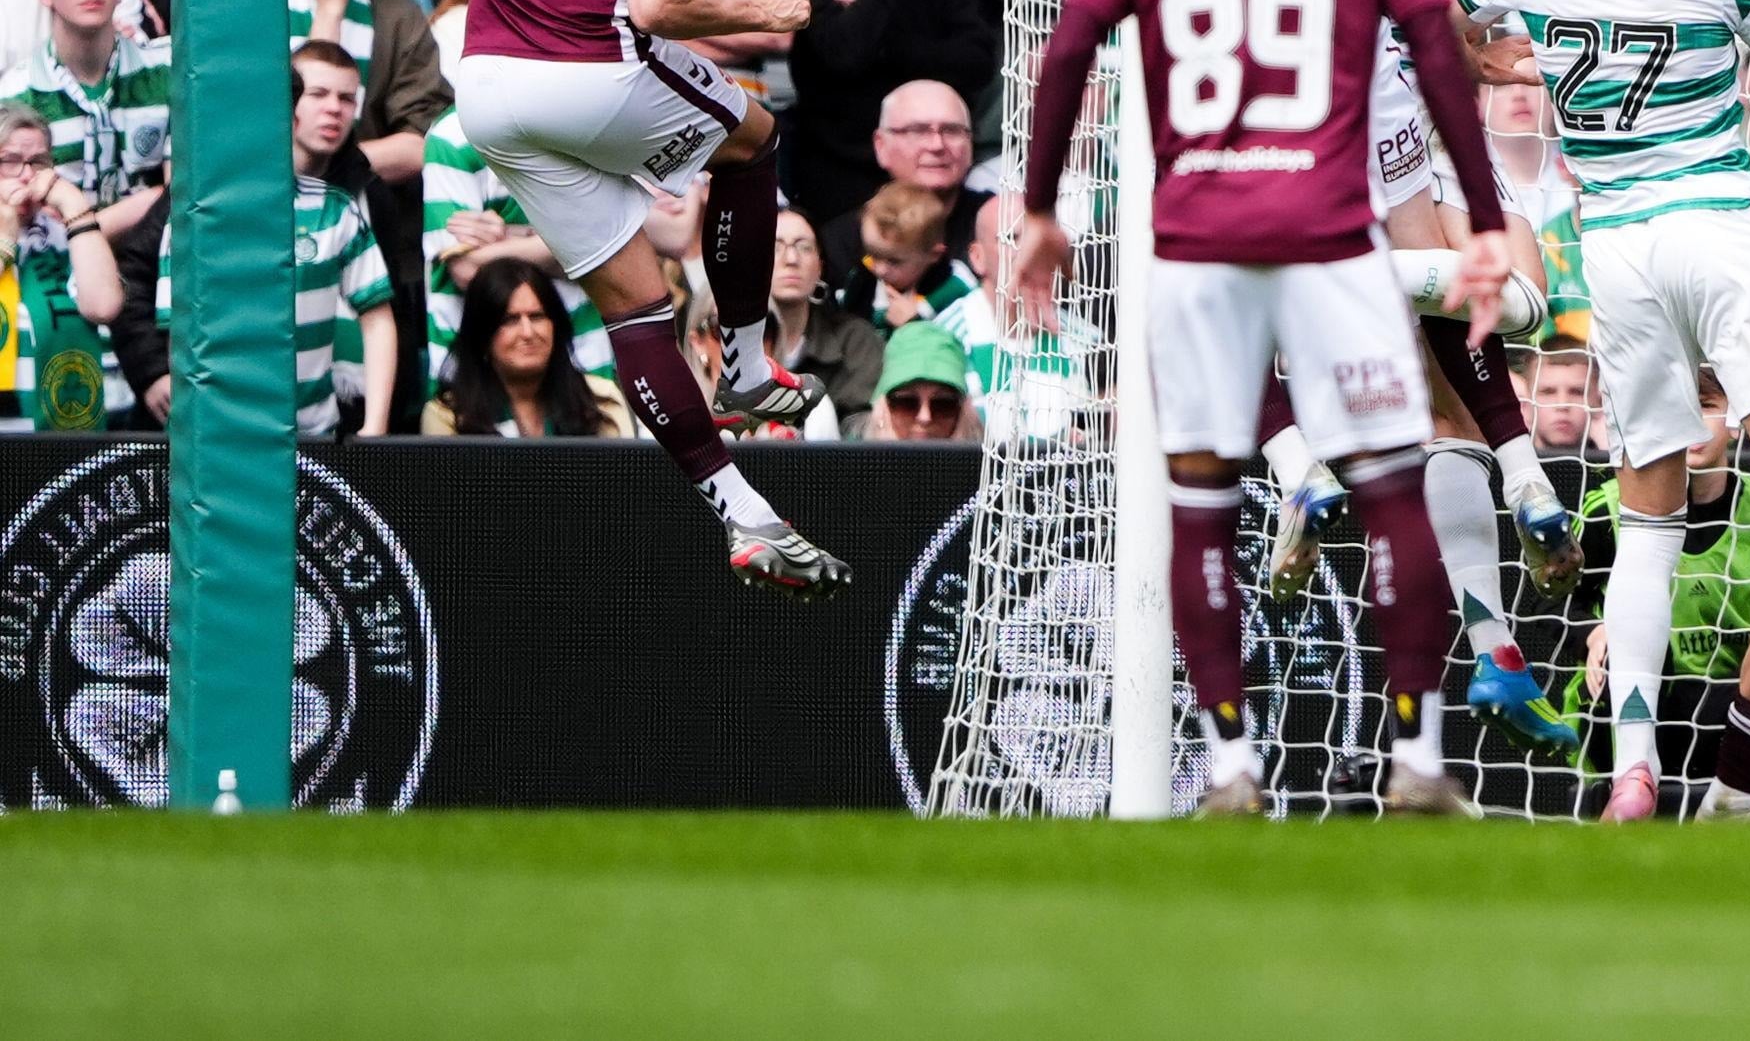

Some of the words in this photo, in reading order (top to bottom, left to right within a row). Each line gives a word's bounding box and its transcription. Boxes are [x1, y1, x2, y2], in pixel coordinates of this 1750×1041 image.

[1544, 16, 1678, 135] 27
[1376, 117, 1421, 164] PPE
[715, 211, 733, 263] HMFC
[633, 376, 670, 426] HMFC
